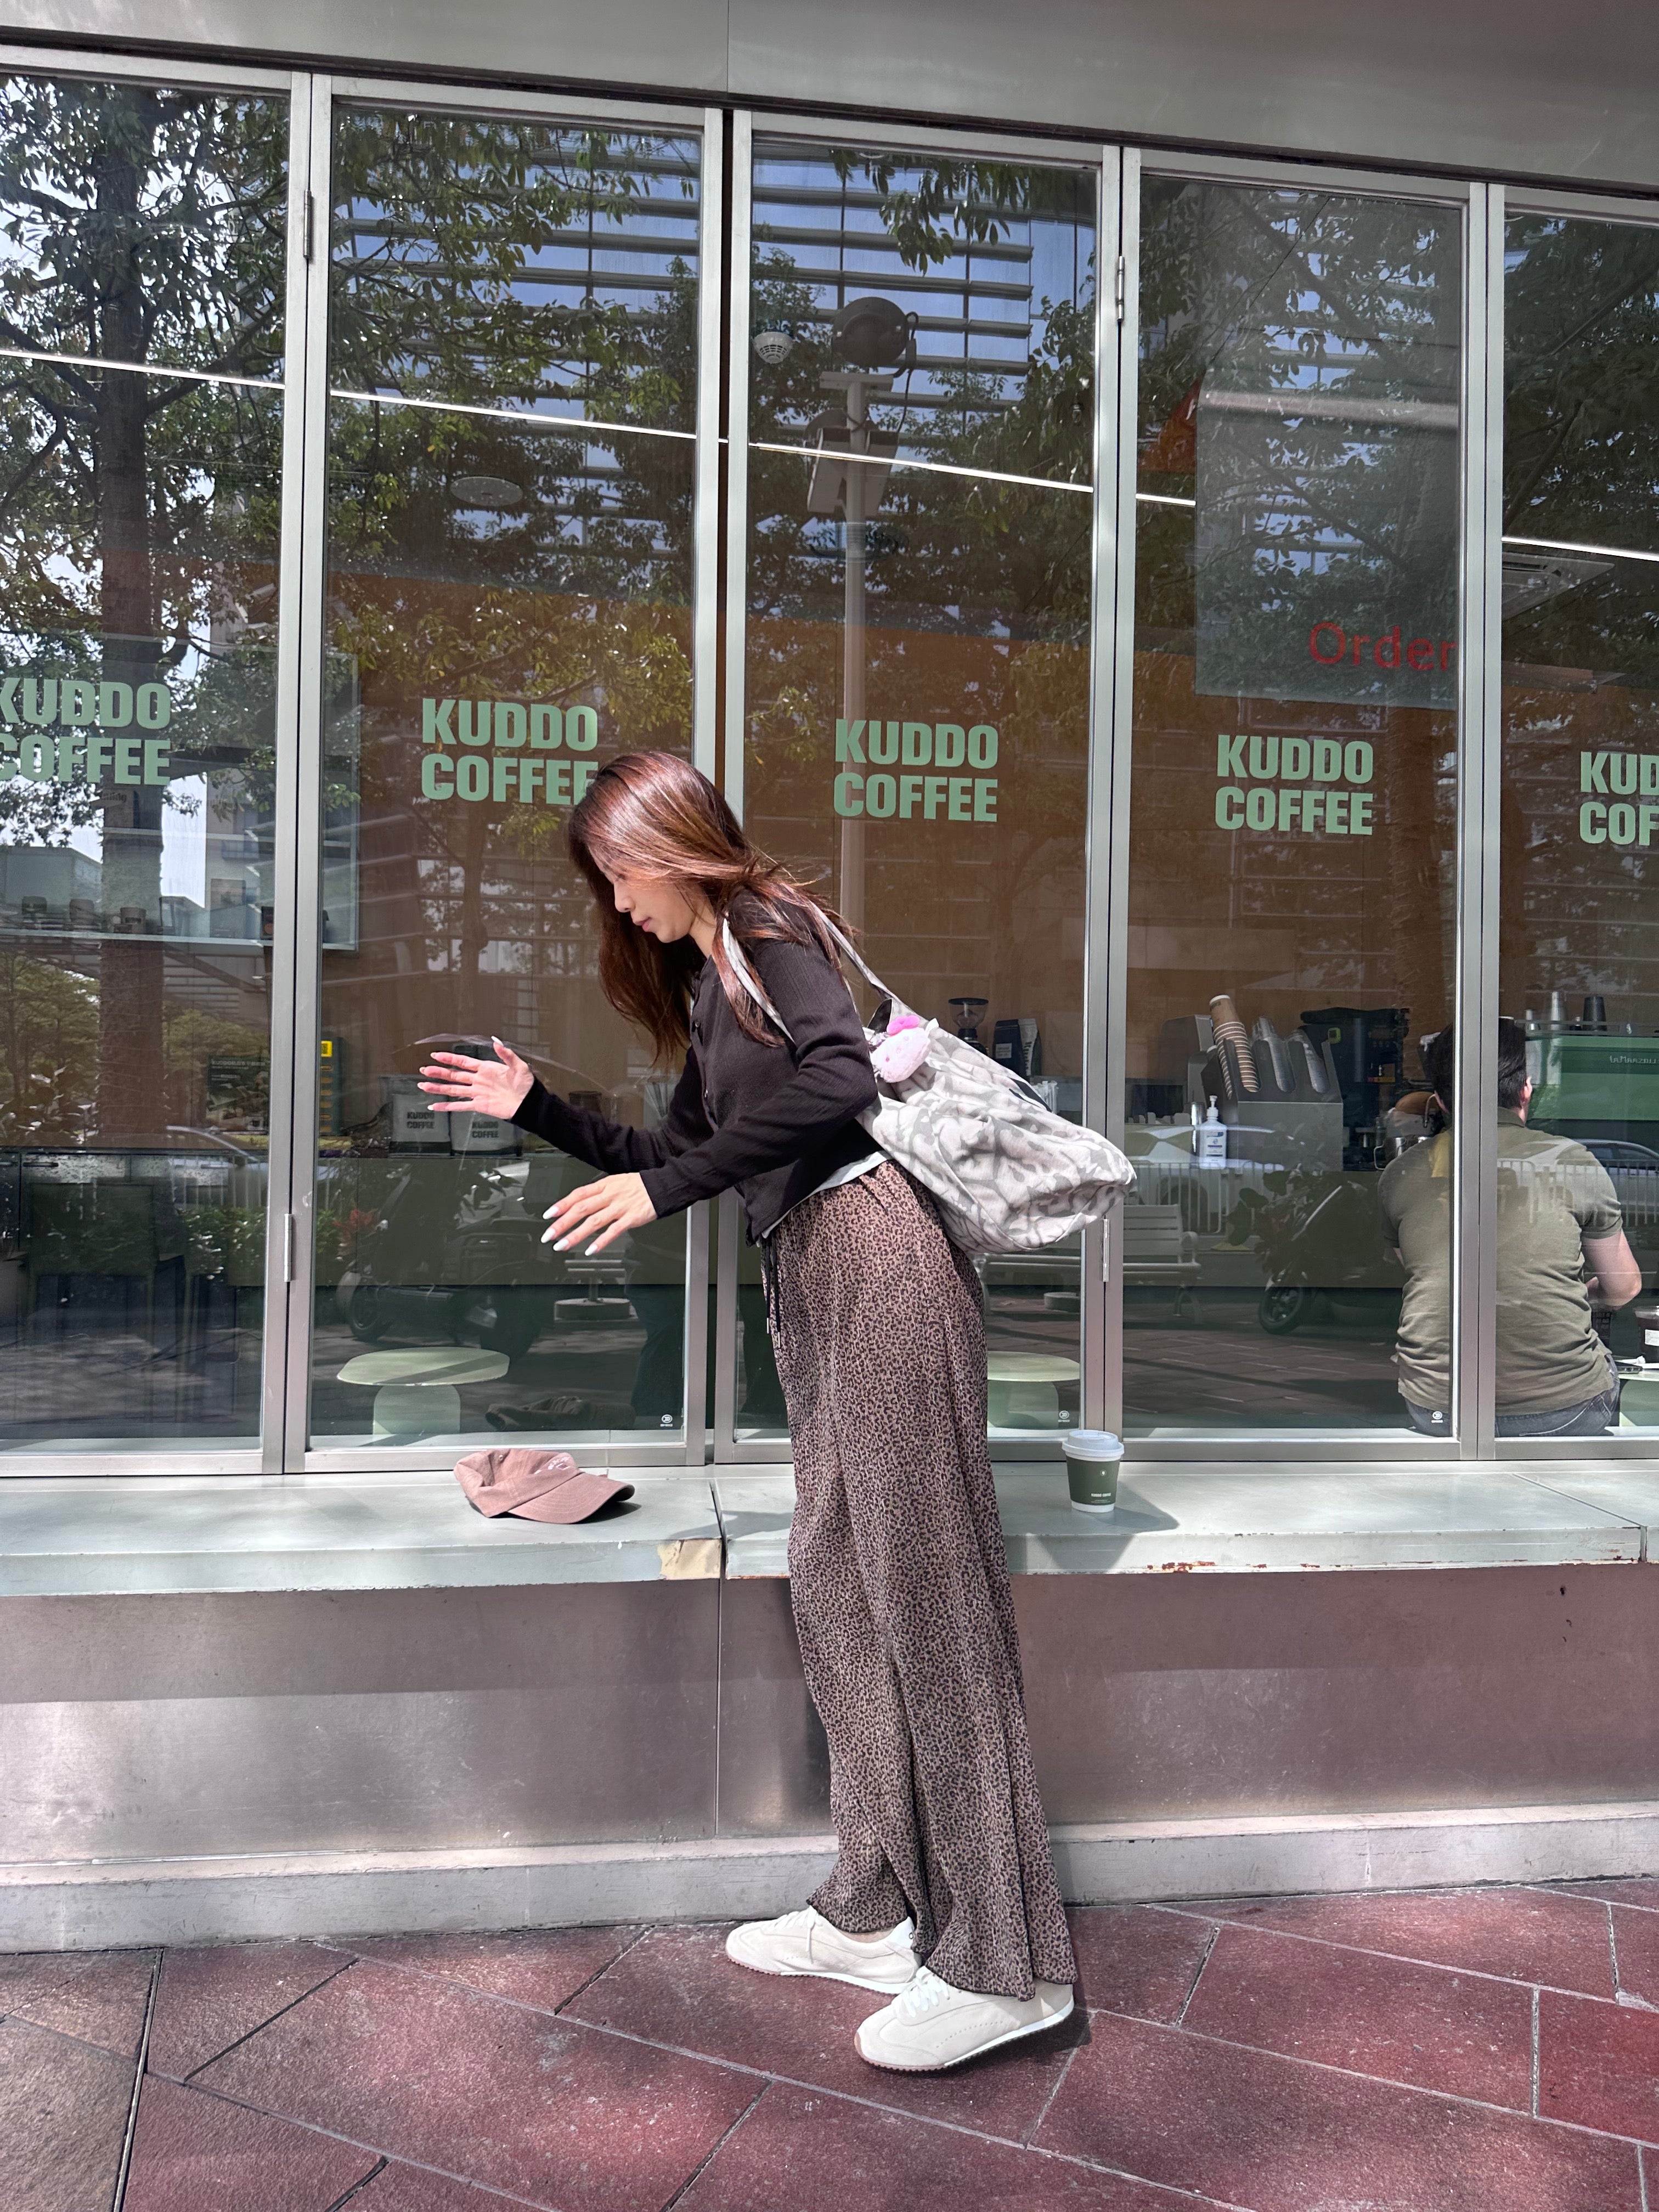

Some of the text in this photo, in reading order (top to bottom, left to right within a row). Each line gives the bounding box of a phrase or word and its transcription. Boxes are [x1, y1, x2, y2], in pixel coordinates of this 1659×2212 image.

[1308, 620, 1457, 672] Order
[0, 677, 171, 730] KUDDO
[422, 698, 598, 752] KUDDO
[835, 718, 998, 769] KUDDO
[1216, 735, 1374, 784] KUDDO
[422, 753, 599, 805] COFFEE
[834, 772, 998, 822] COFFEE
[1215, 786, 1374, 836] COFFEE
[1579, 802, 1659, 846] COF
[407, 1121, 435, 1129] COFFEE
[472, 1130, 499, 1138] COFFEE
